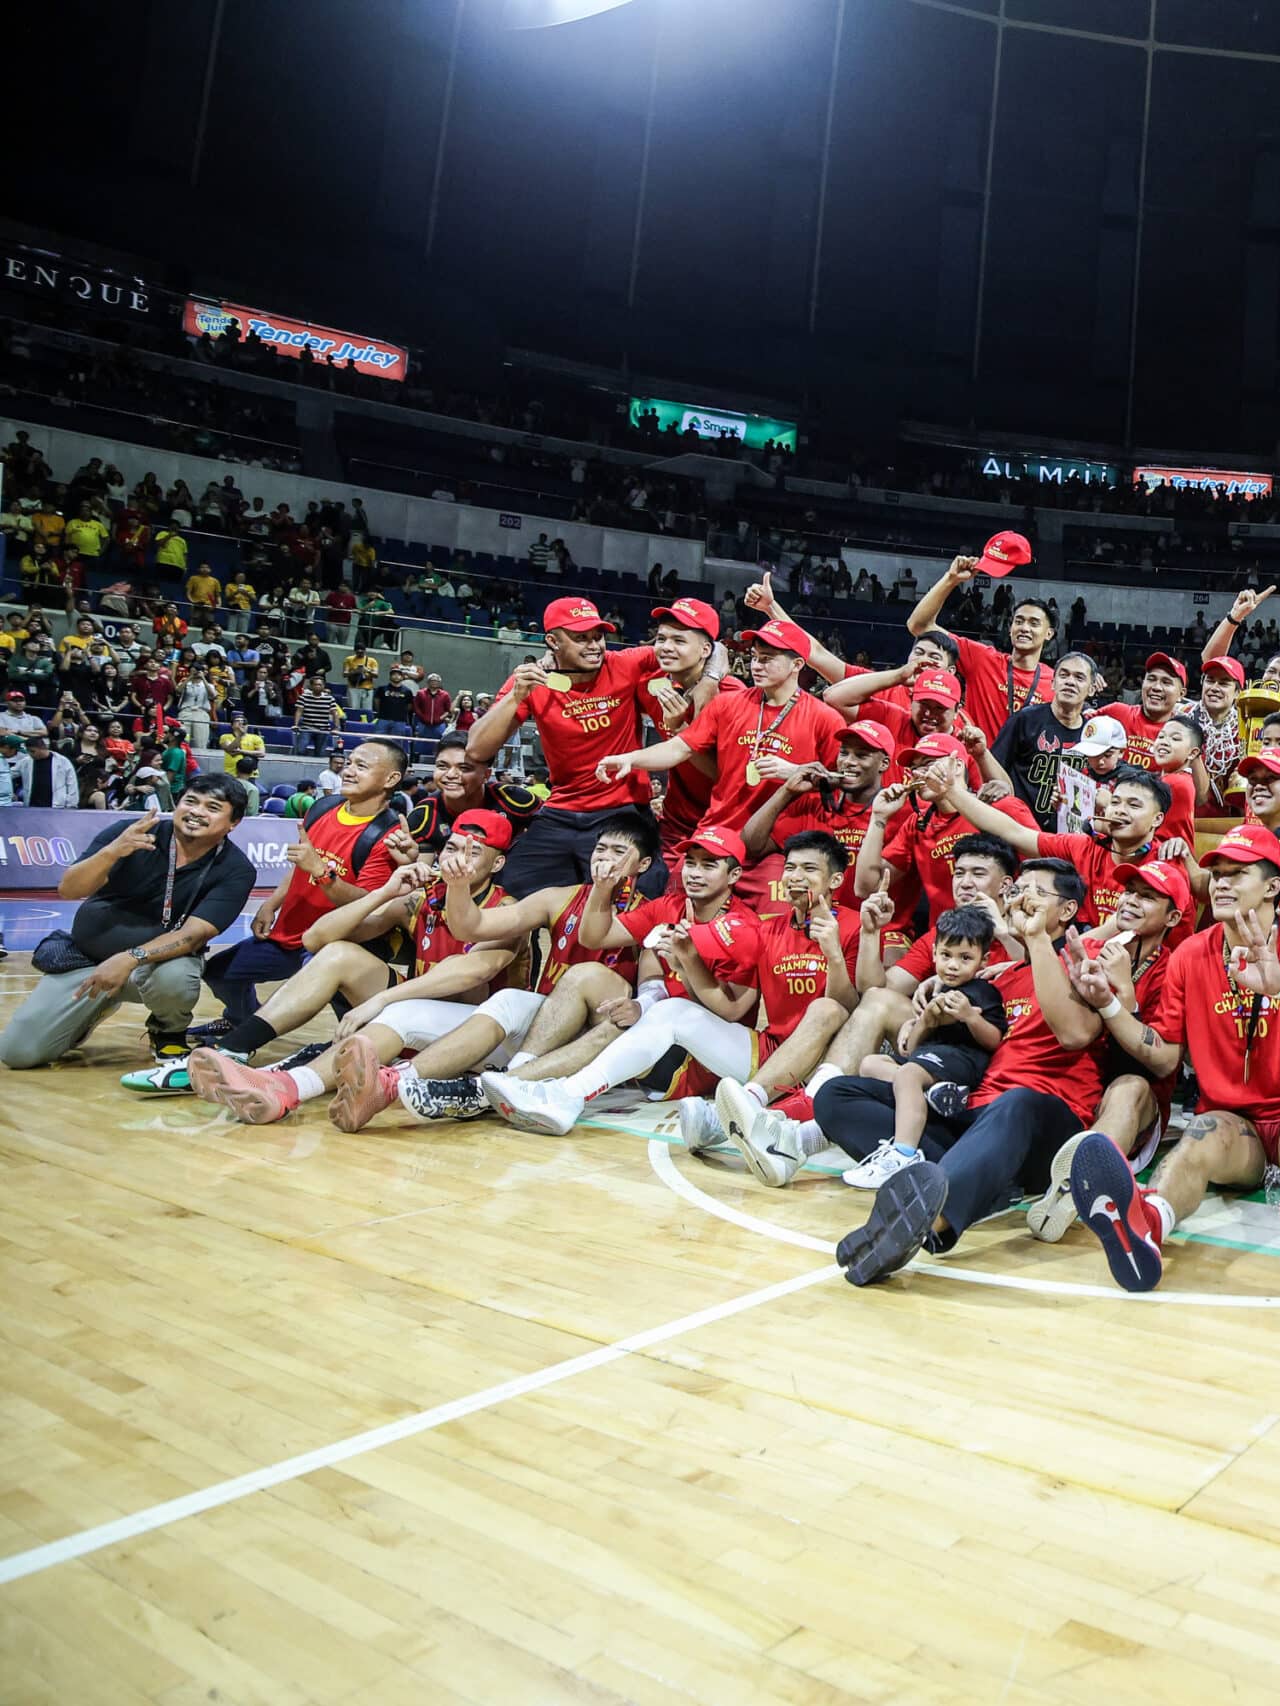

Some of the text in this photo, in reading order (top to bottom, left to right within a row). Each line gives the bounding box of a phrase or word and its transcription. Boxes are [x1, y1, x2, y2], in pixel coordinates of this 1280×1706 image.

[249, 319, 335, 352] Tender
[332, 343, 399, 369] Juicy
[500, 515, 521, 528] 202
[579, 715, 611, 733] 100
[1127, 751, 1151, 769] 100
[8, 836, 77, 867] 100
[247, 842, 288, 862] NCA
[786, 977, 816, 994] 100
